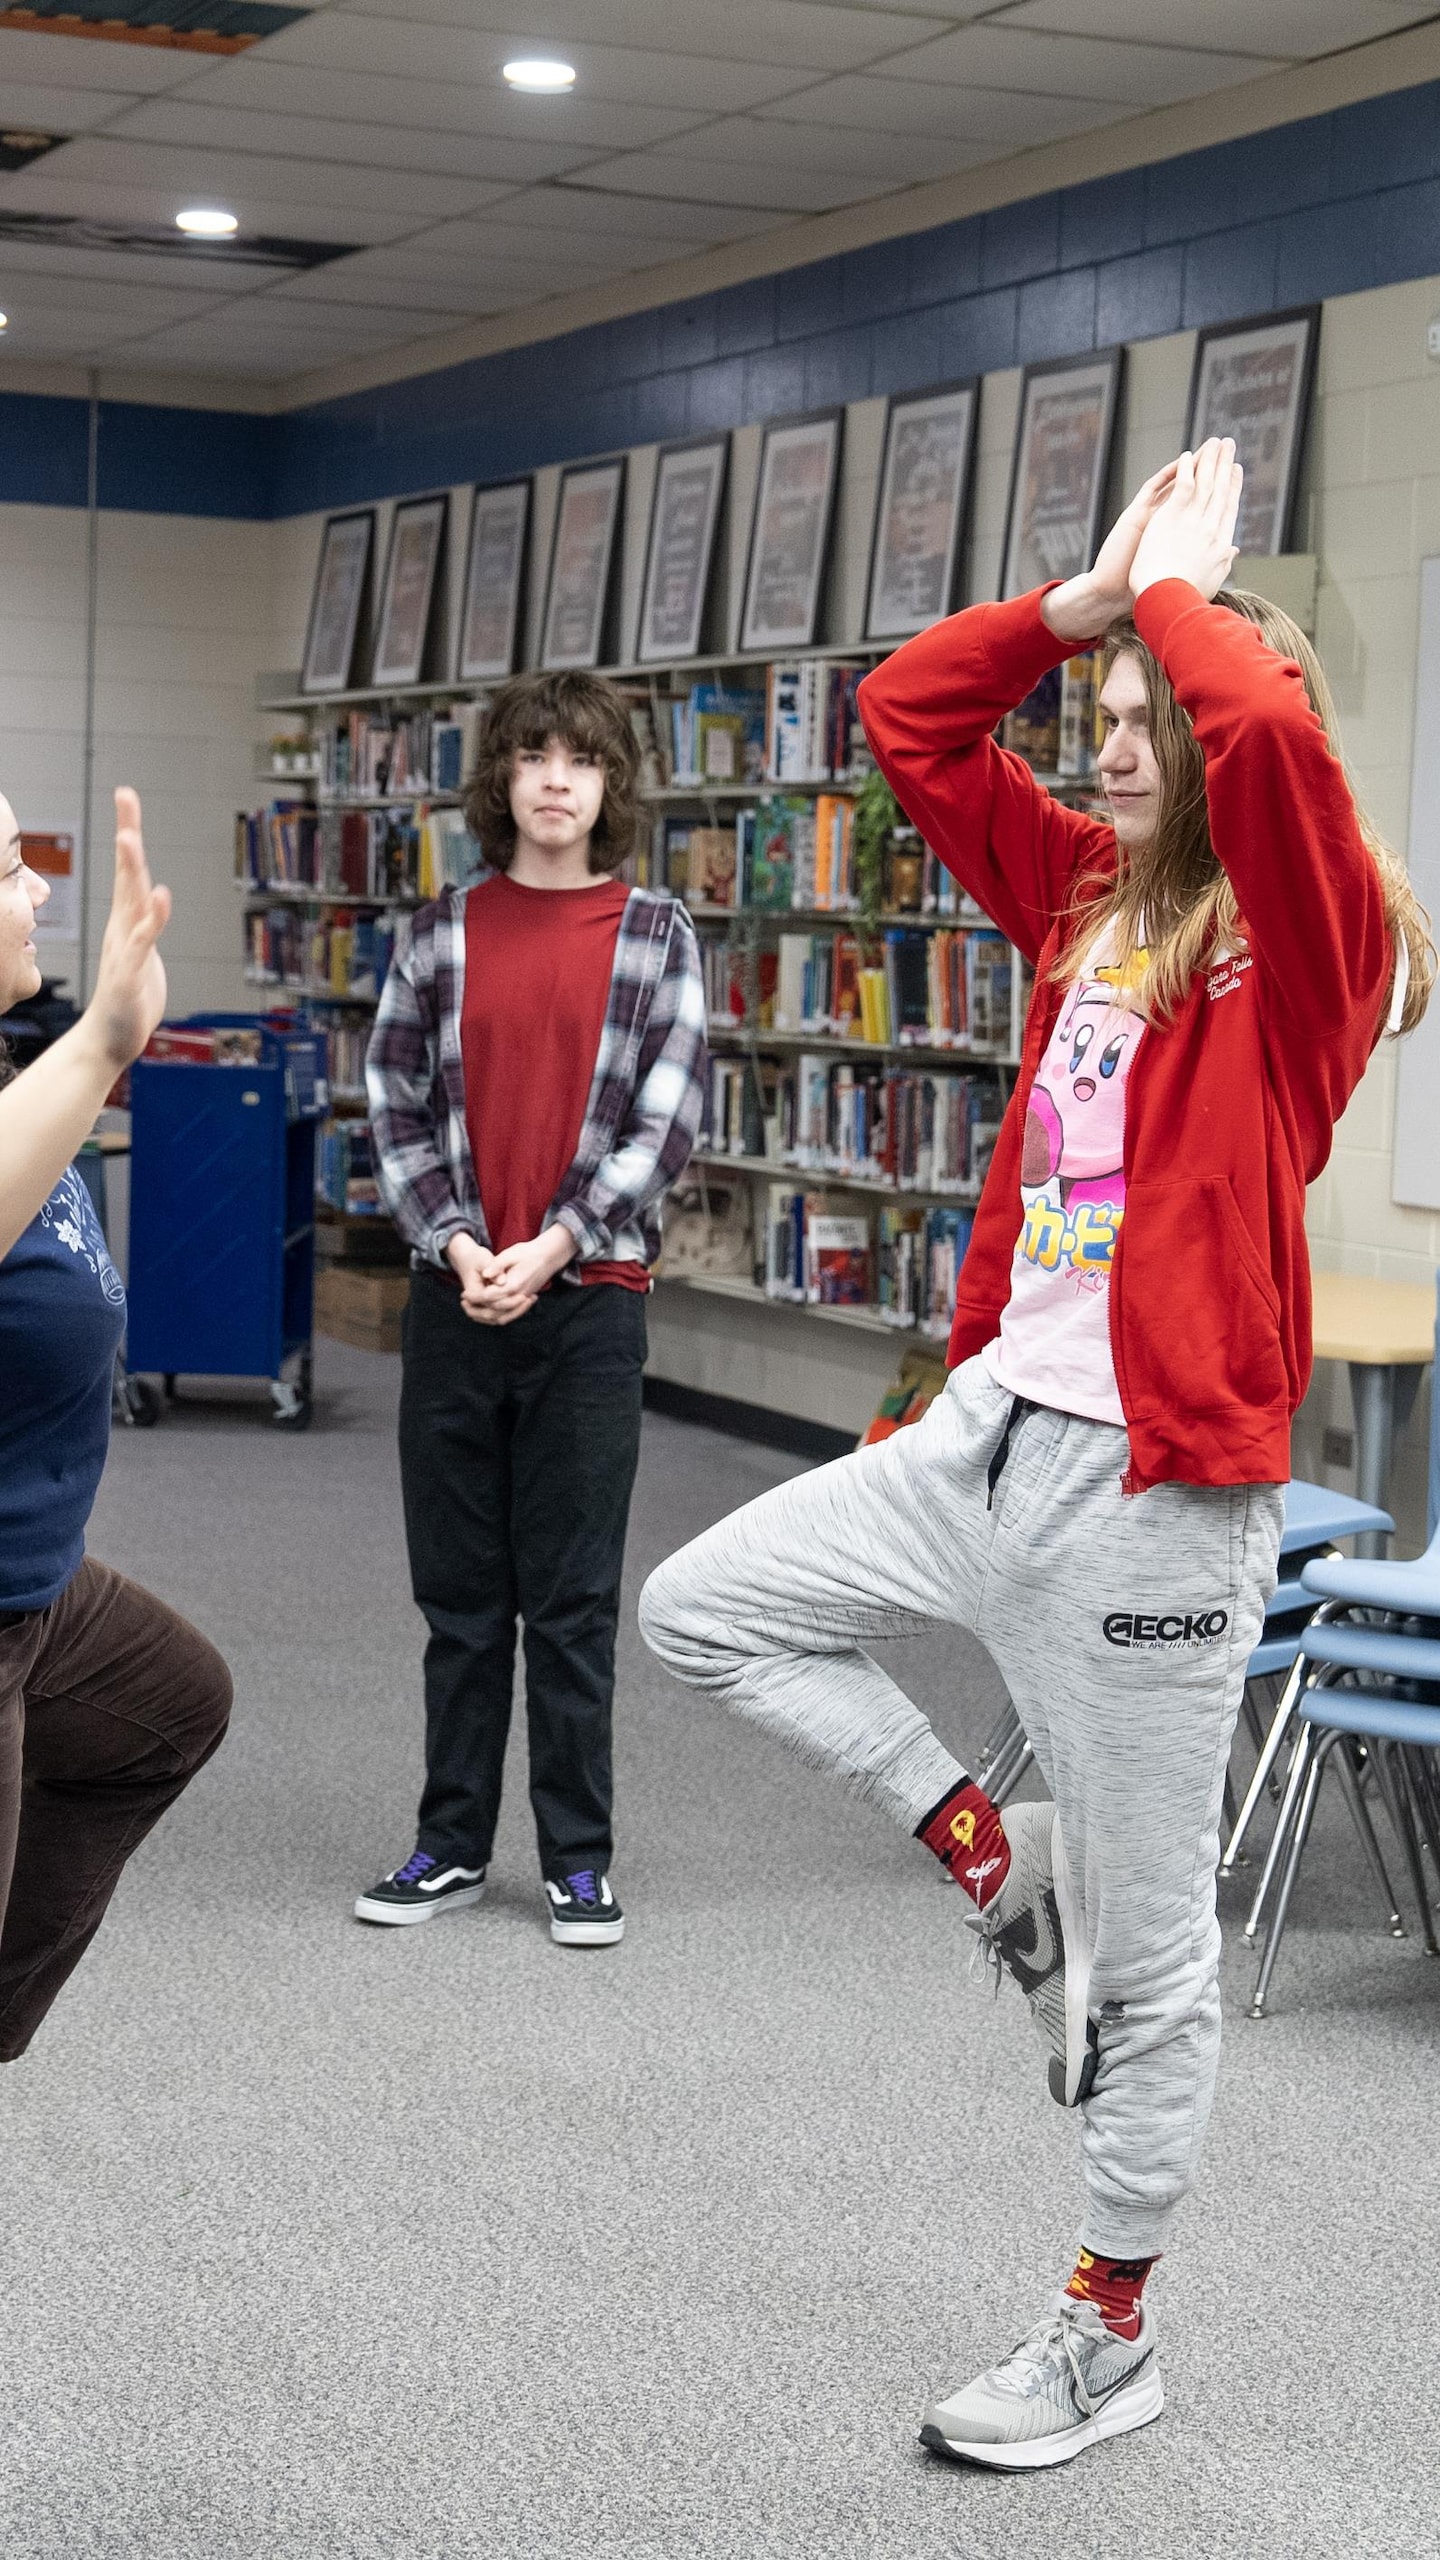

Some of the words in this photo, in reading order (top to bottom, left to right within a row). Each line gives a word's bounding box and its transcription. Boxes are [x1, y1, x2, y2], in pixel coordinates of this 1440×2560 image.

[1231, 956, 1253, 975] Falls
[1210, 976, 1242, 1000] Canada
[1103, 1609, 1228, 1647] GECKO
[1131, 1641, 1147, 1649] WE
[1149, 1641, 1168, 1650] ARE
[1187, 1634, 1227, 1648] UNLIMITED
